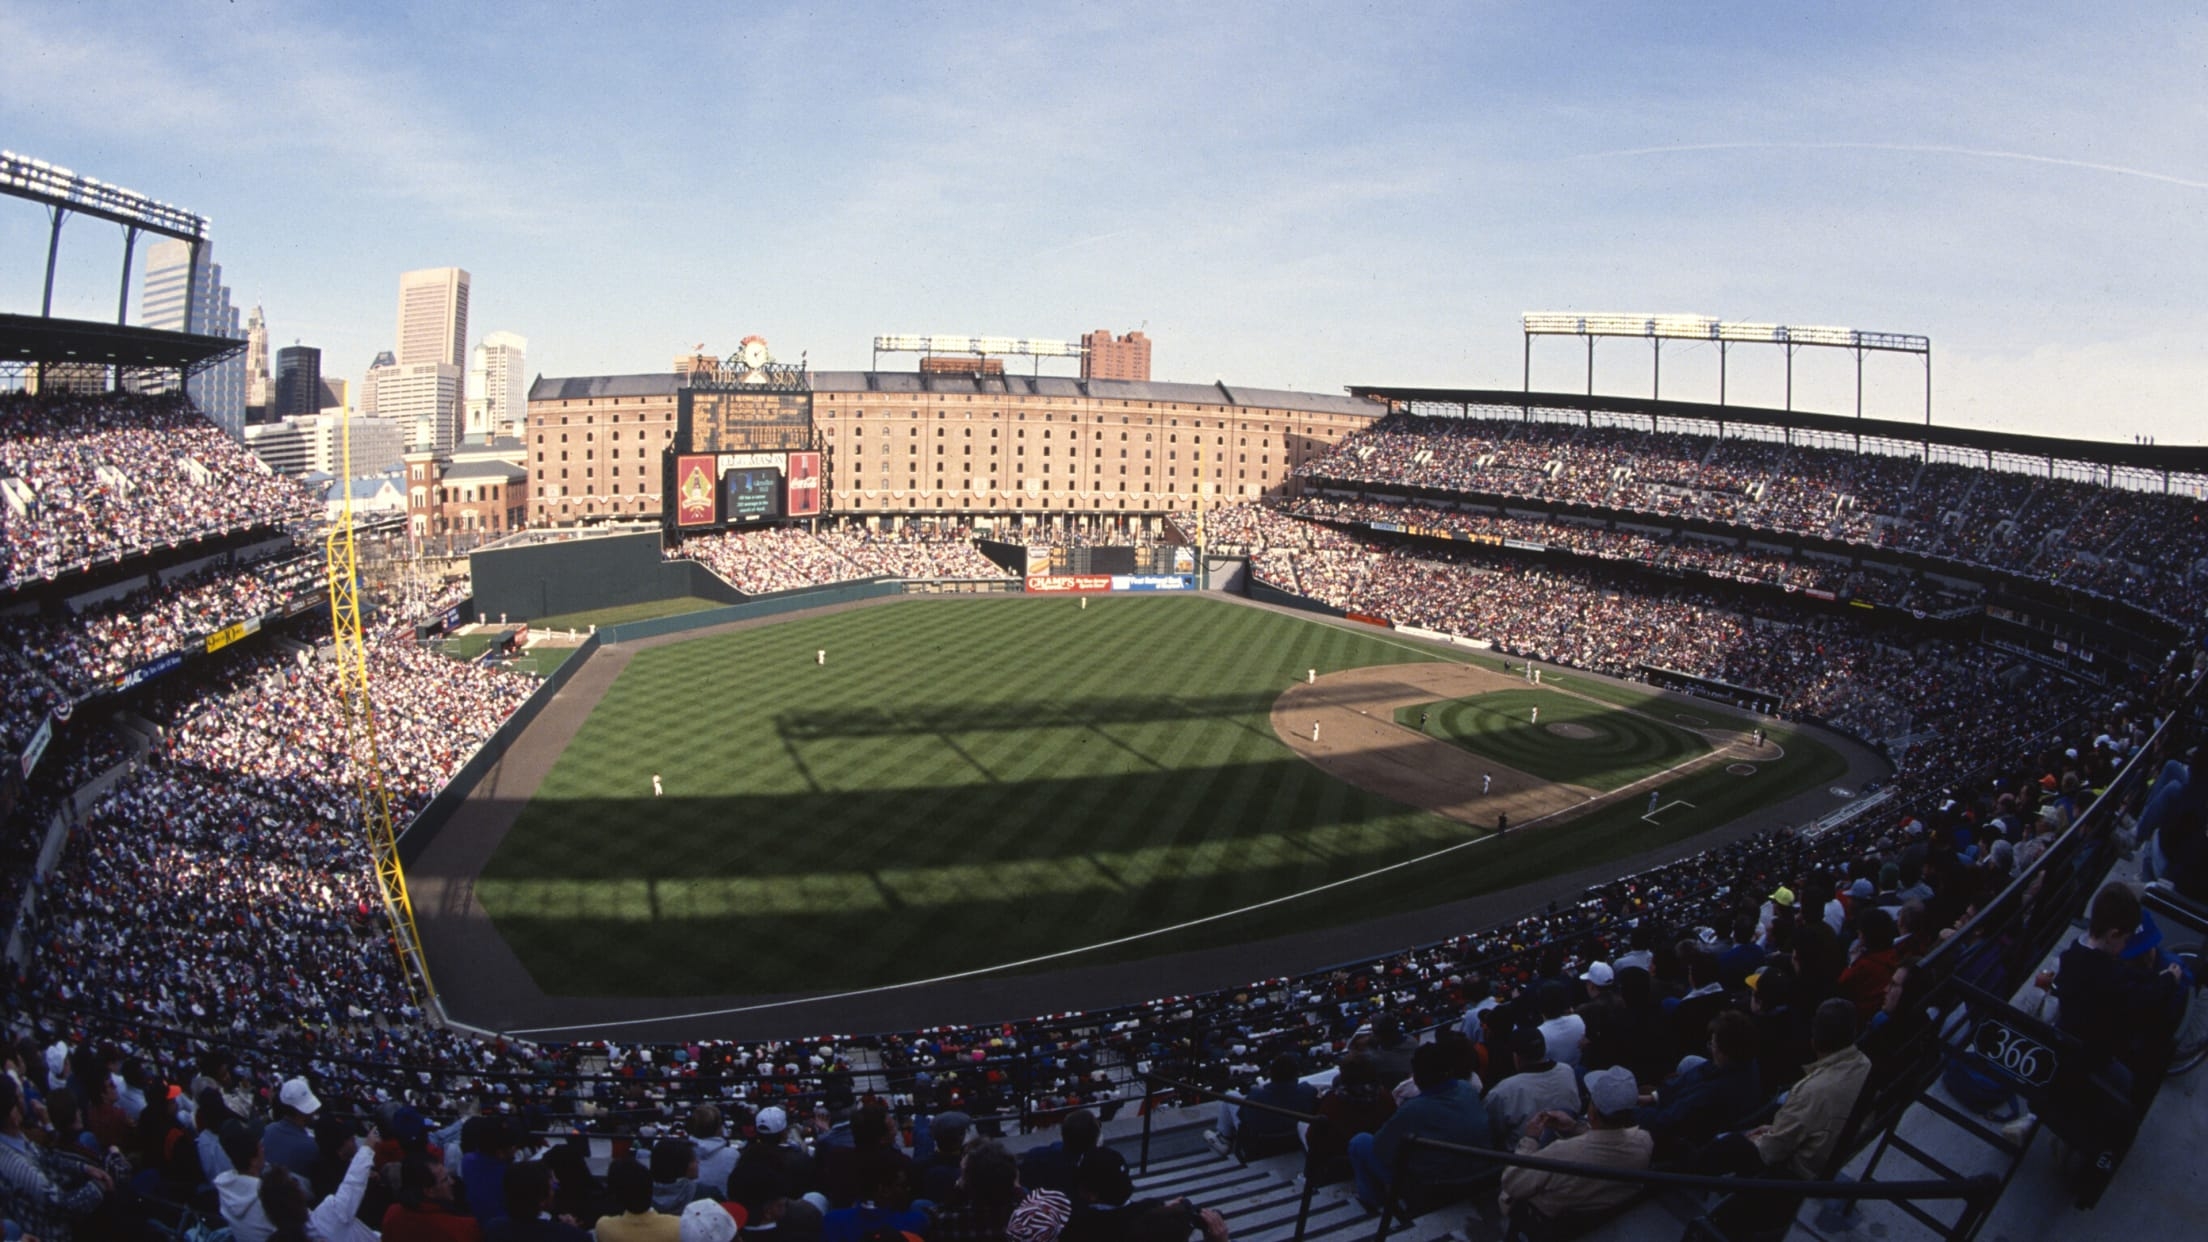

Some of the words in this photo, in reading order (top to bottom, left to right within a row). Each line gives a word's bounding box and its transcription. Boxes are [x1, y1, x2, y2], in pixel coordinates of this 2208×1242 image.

[711, 369, 737, 383] THE
[773, 370, 798, 385] SUN
[749, 455, 784, 465] MASON
[1029, 577, 1075, 589] CHAMPS
[1986, 1028, 2042, 1078] 366
